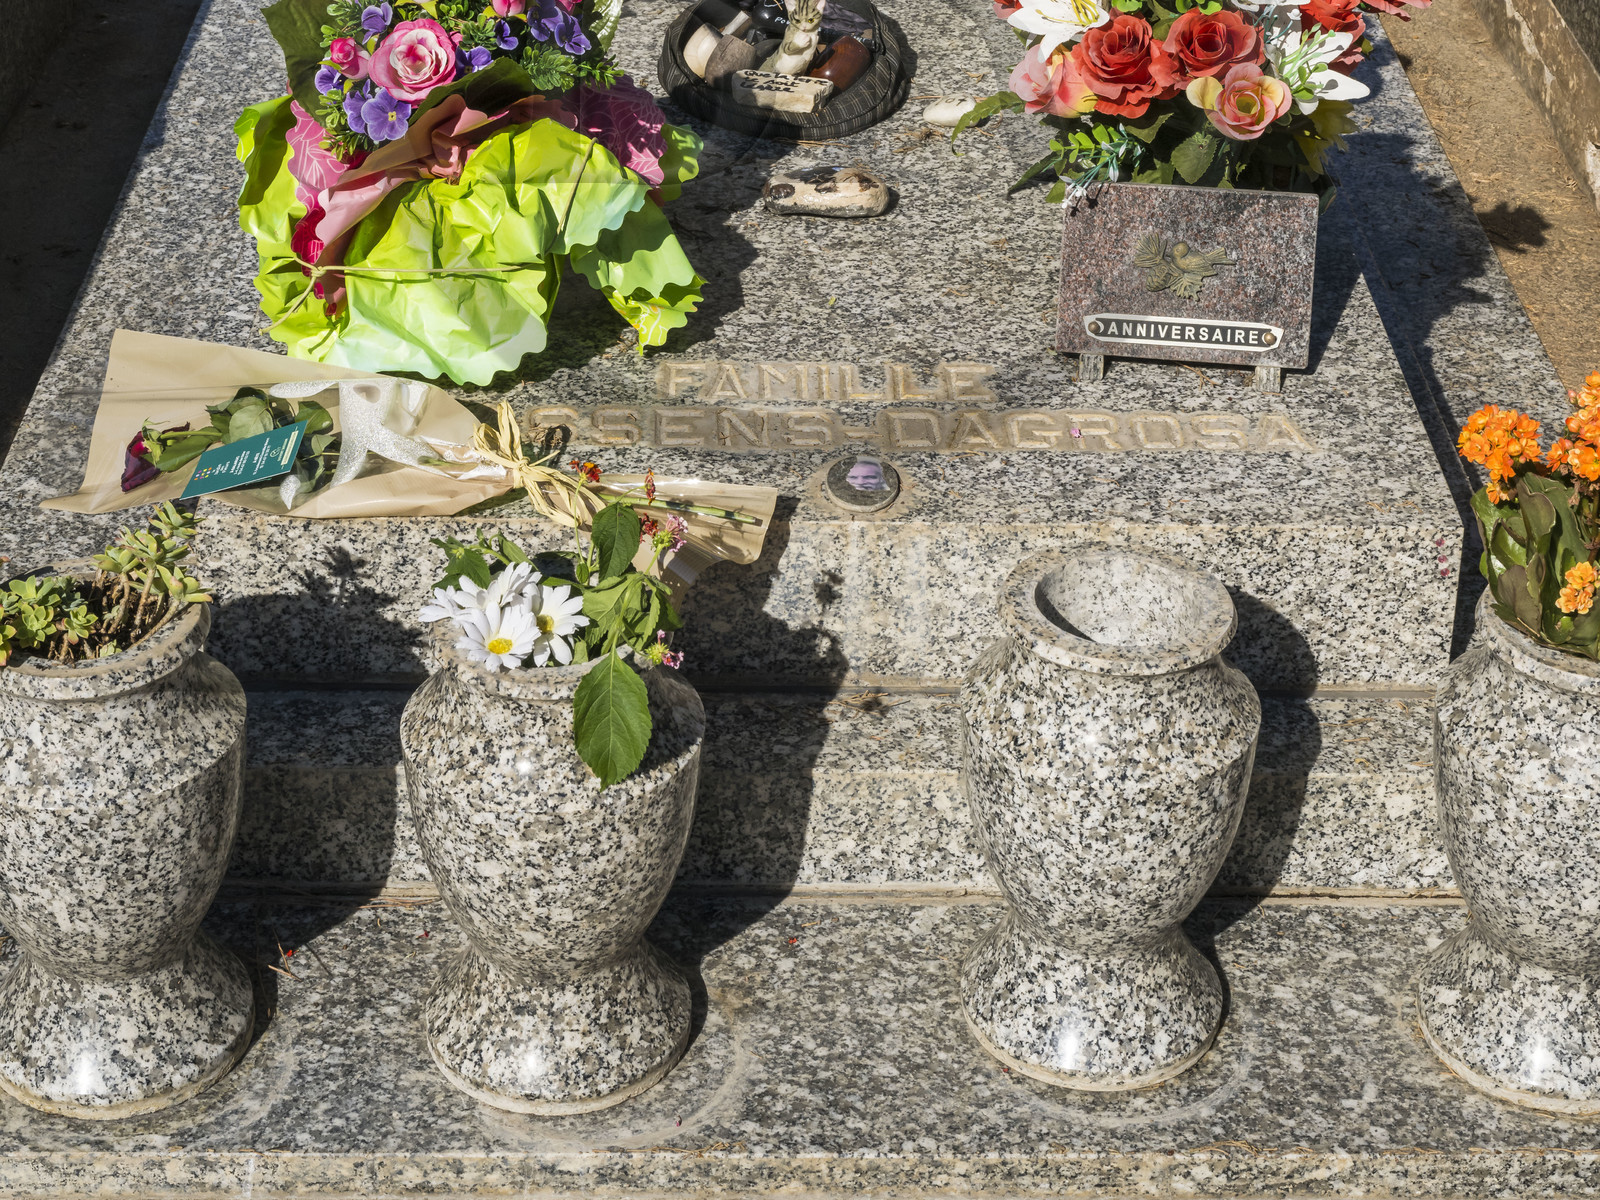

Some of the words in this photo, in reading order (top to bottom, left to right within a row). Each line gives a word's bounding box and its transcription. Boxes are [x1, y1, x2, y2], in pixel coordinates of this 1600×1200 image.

[1106, 320, 1260, 345] ANNIVERSAIRE
[660, 361, 994, 401] FAMILLE
[527, 405, 1314, 451] SSENS-DAGROSA
